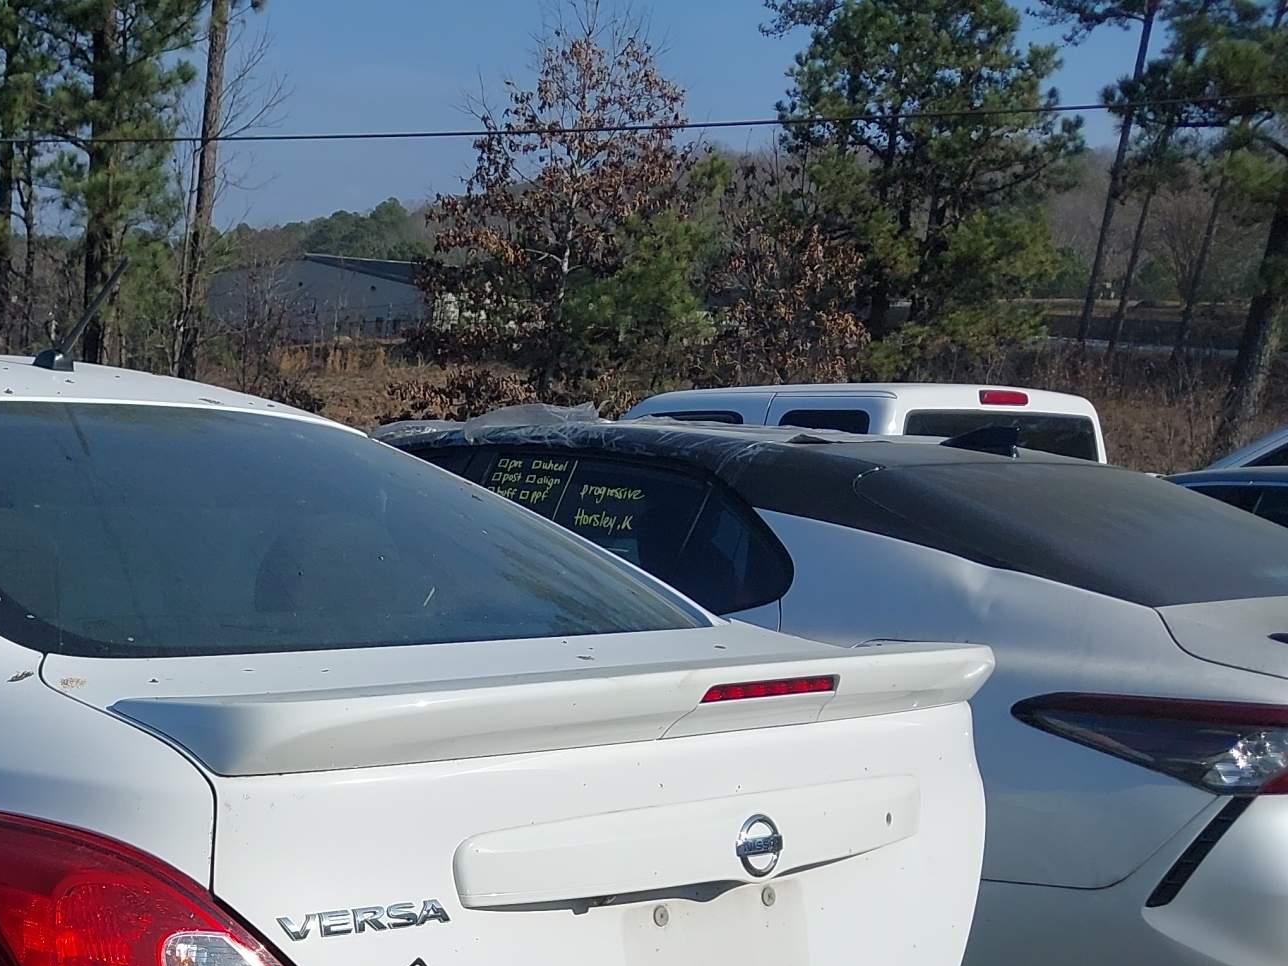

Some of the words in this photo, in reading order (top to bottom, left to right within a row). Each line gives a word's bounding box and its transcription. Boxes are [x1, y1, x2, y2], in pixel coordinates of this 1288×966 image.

[501, 471, 522, 484] post
[537, 475, 560, 489] align
[276, 898, 451, 942] VERSA
